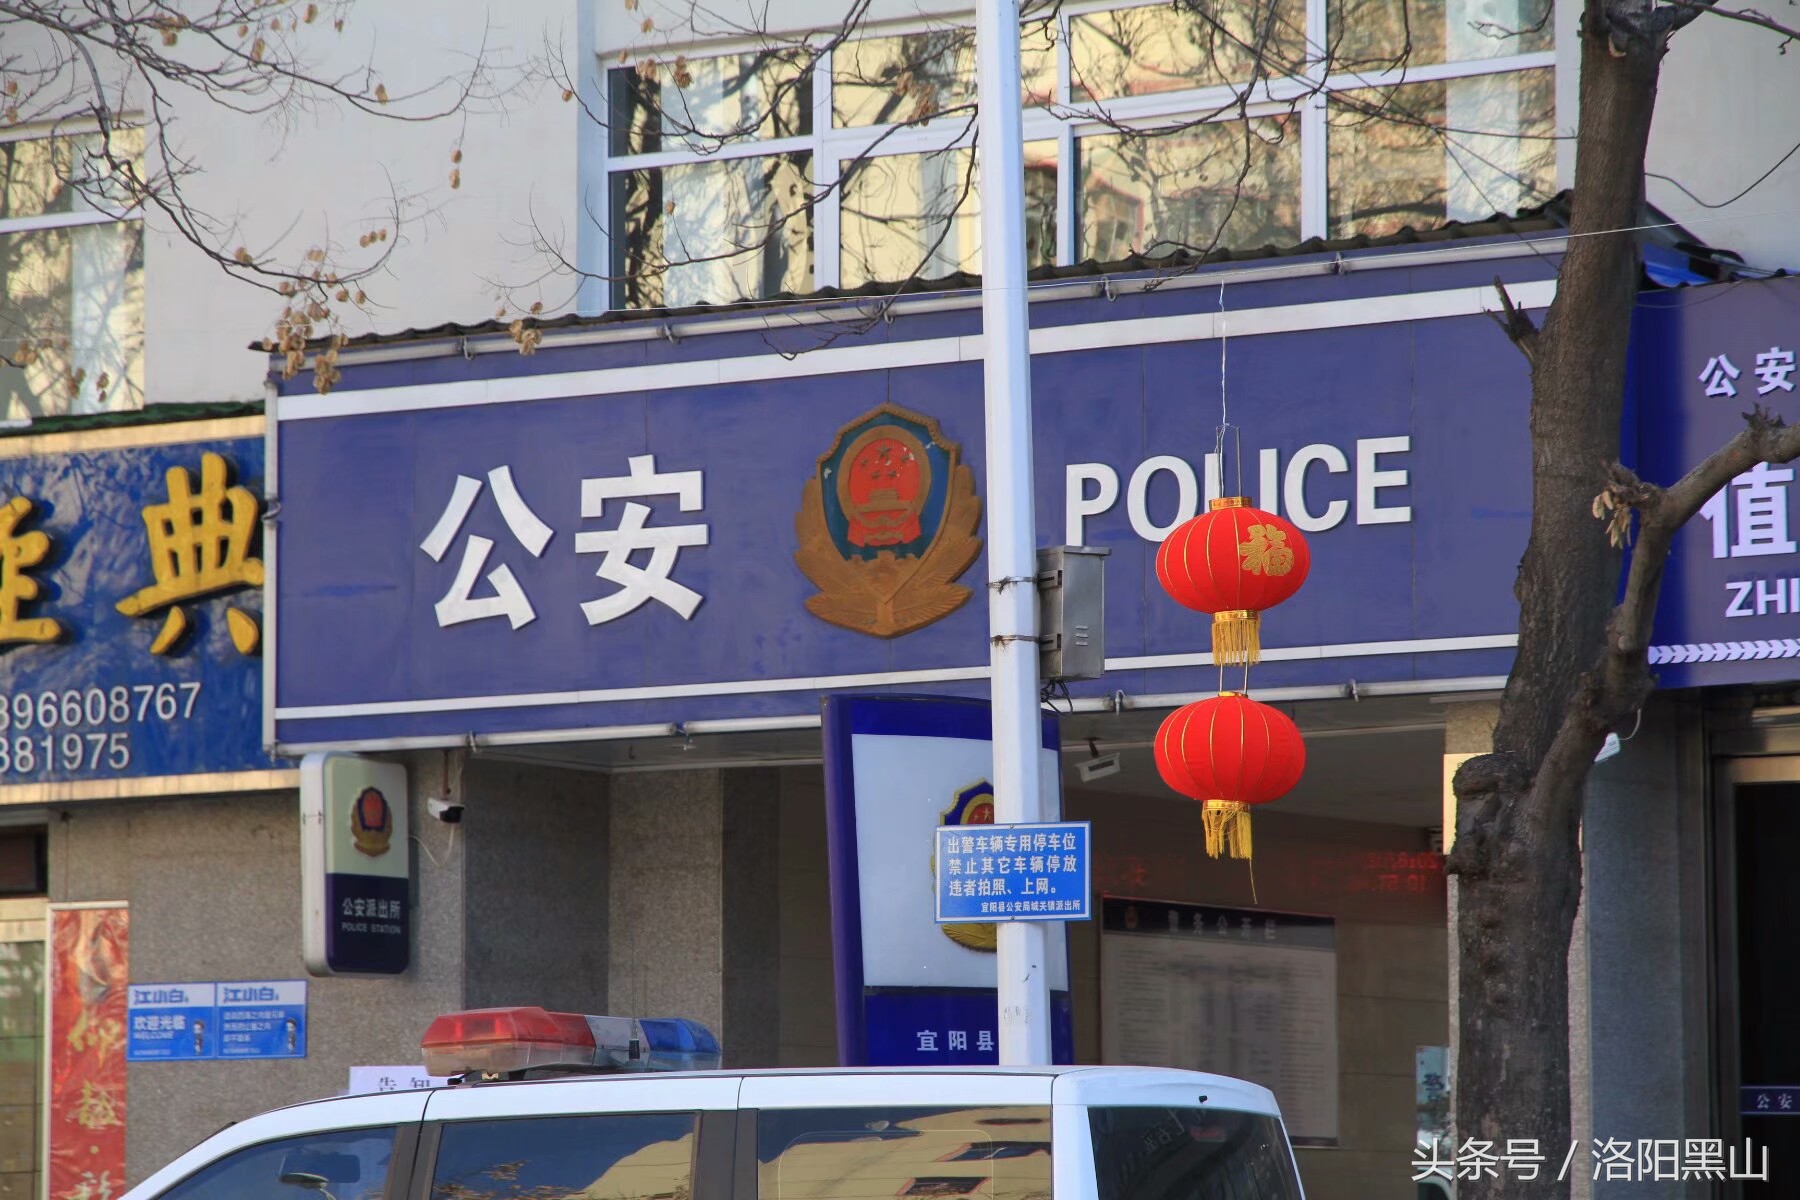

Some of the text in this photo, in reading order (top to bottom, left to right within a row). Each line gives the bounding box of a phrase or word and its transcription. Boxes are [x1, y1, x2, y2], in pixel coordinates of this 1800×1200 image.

[1699, 346, 1795, 398] 公安
[1700, 461, 1797, 558] 值
[420, 454, 709, 630] 公安
[947, 832, 1076, 854] 出警车辆专用停车位
[949, 854, 1077, 876] 禁止其它车辆停放
[341, 897, 402, 920] 公安派出所
[223, 986, 275, 1003] 江小白
[916, 1029, 995, 1051] 宜阳县
[1756, 1093, 1793, 1110] 公安
